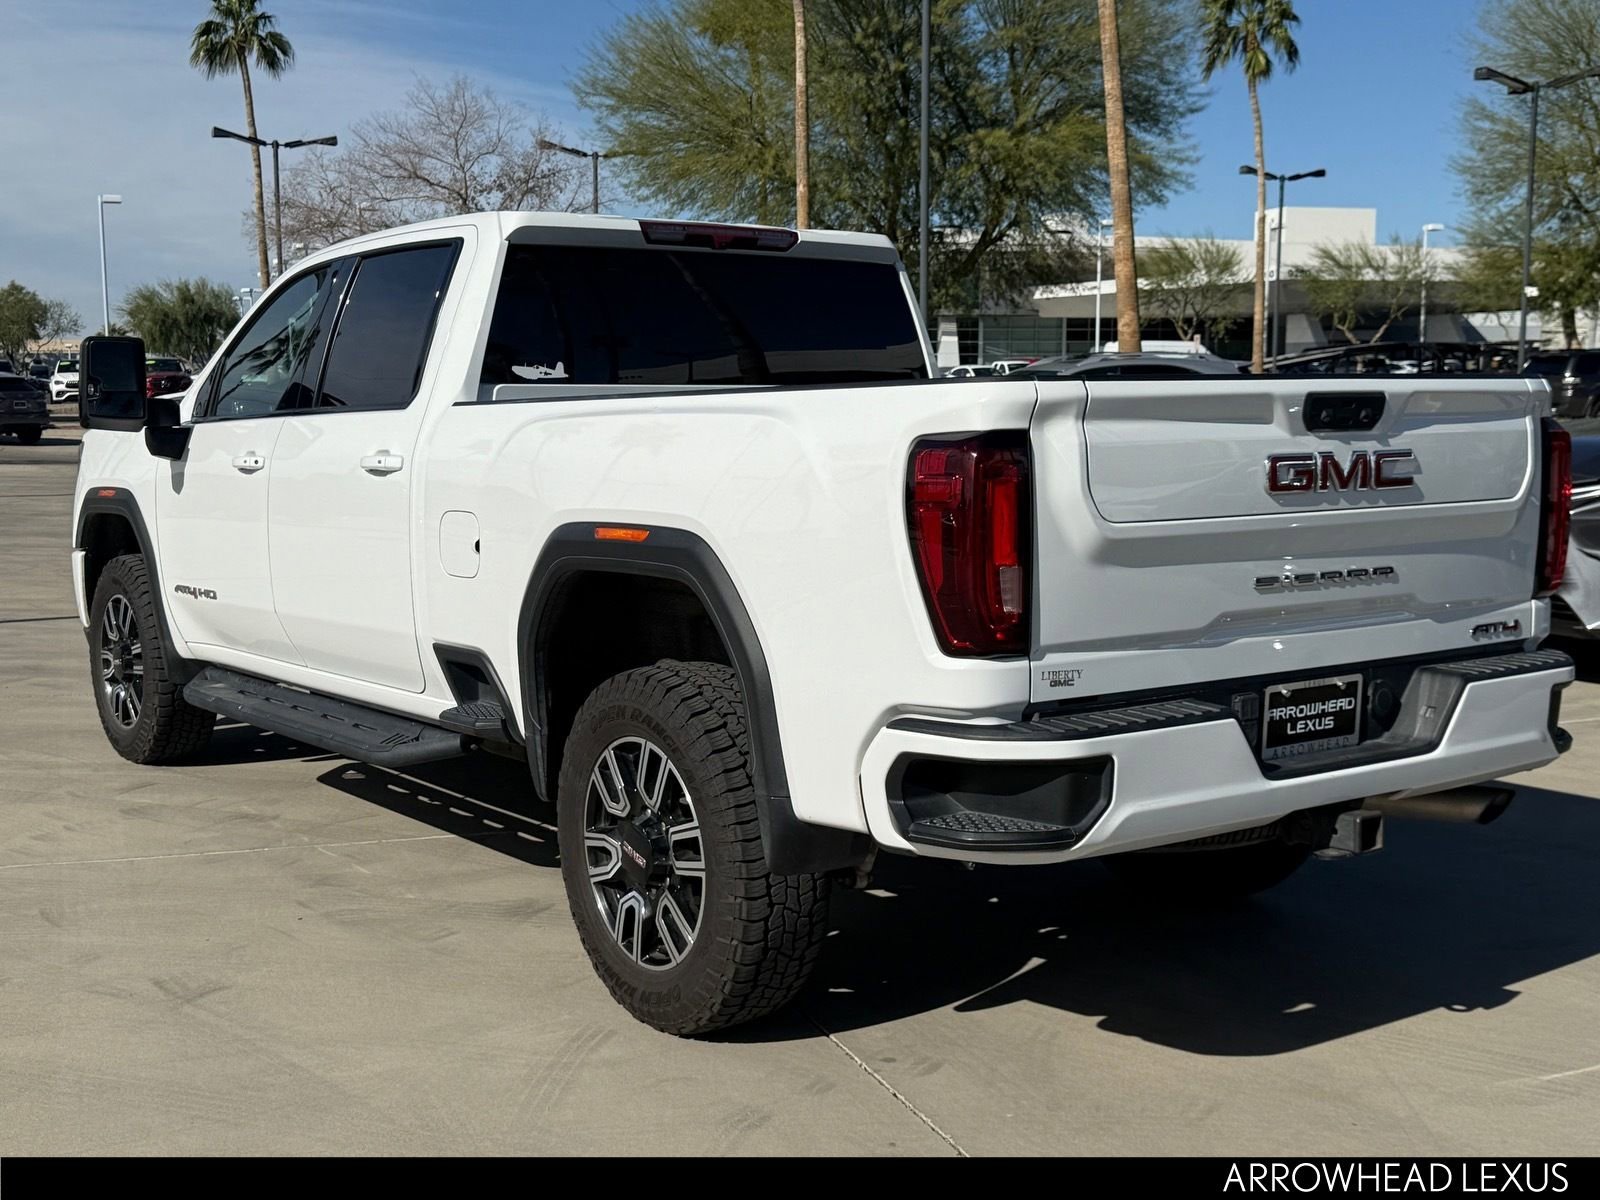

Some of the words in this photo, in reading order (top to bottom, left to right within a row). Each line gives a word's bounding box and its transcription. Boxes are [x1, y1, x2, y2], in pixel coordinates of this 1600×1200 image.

[1264, 449, 1415, 495] GMC
[1254, 566, 1395, 589] SIERRA
[1041, 669, 1083, 681] LIBERTY
[1049, 679, 1075, 688] GMC
[1268, 697, 1356, 721] ARROWHEAD
[1287, 716, 1335, 735] LEXUS
[1271, 736, 1350, 760] ARROWHEAD
